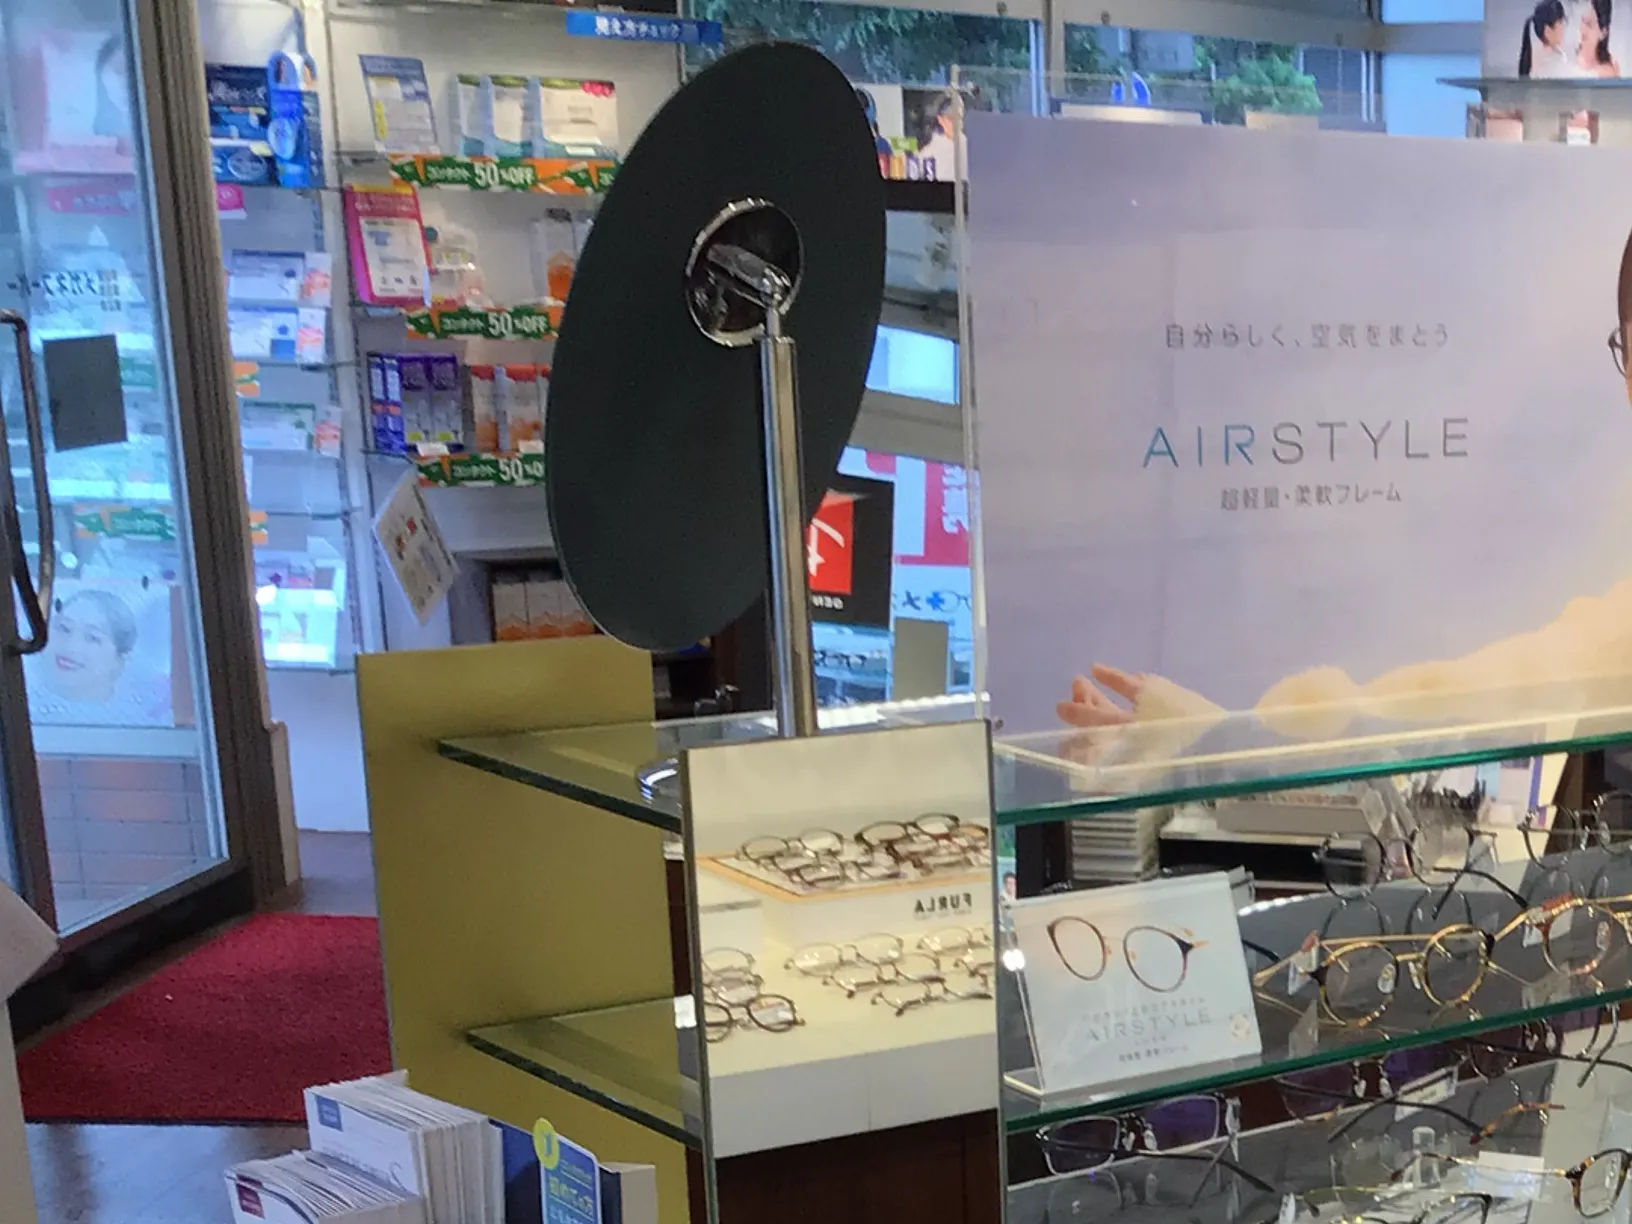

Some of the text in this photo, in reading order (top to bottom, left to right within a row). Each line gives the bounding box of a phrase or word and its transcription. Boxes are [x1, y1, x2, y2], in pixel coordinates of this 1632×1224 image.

[1166, 322, 1449, 349] 自分らしく、空気をまとう
[1143, 418, 1469, 468] AIRSTYLE
[1220, 482, 1402, 512] 超軽量・柔軟フレーム
[1086, 1006, 1212, 1042] AIRSTYLE
